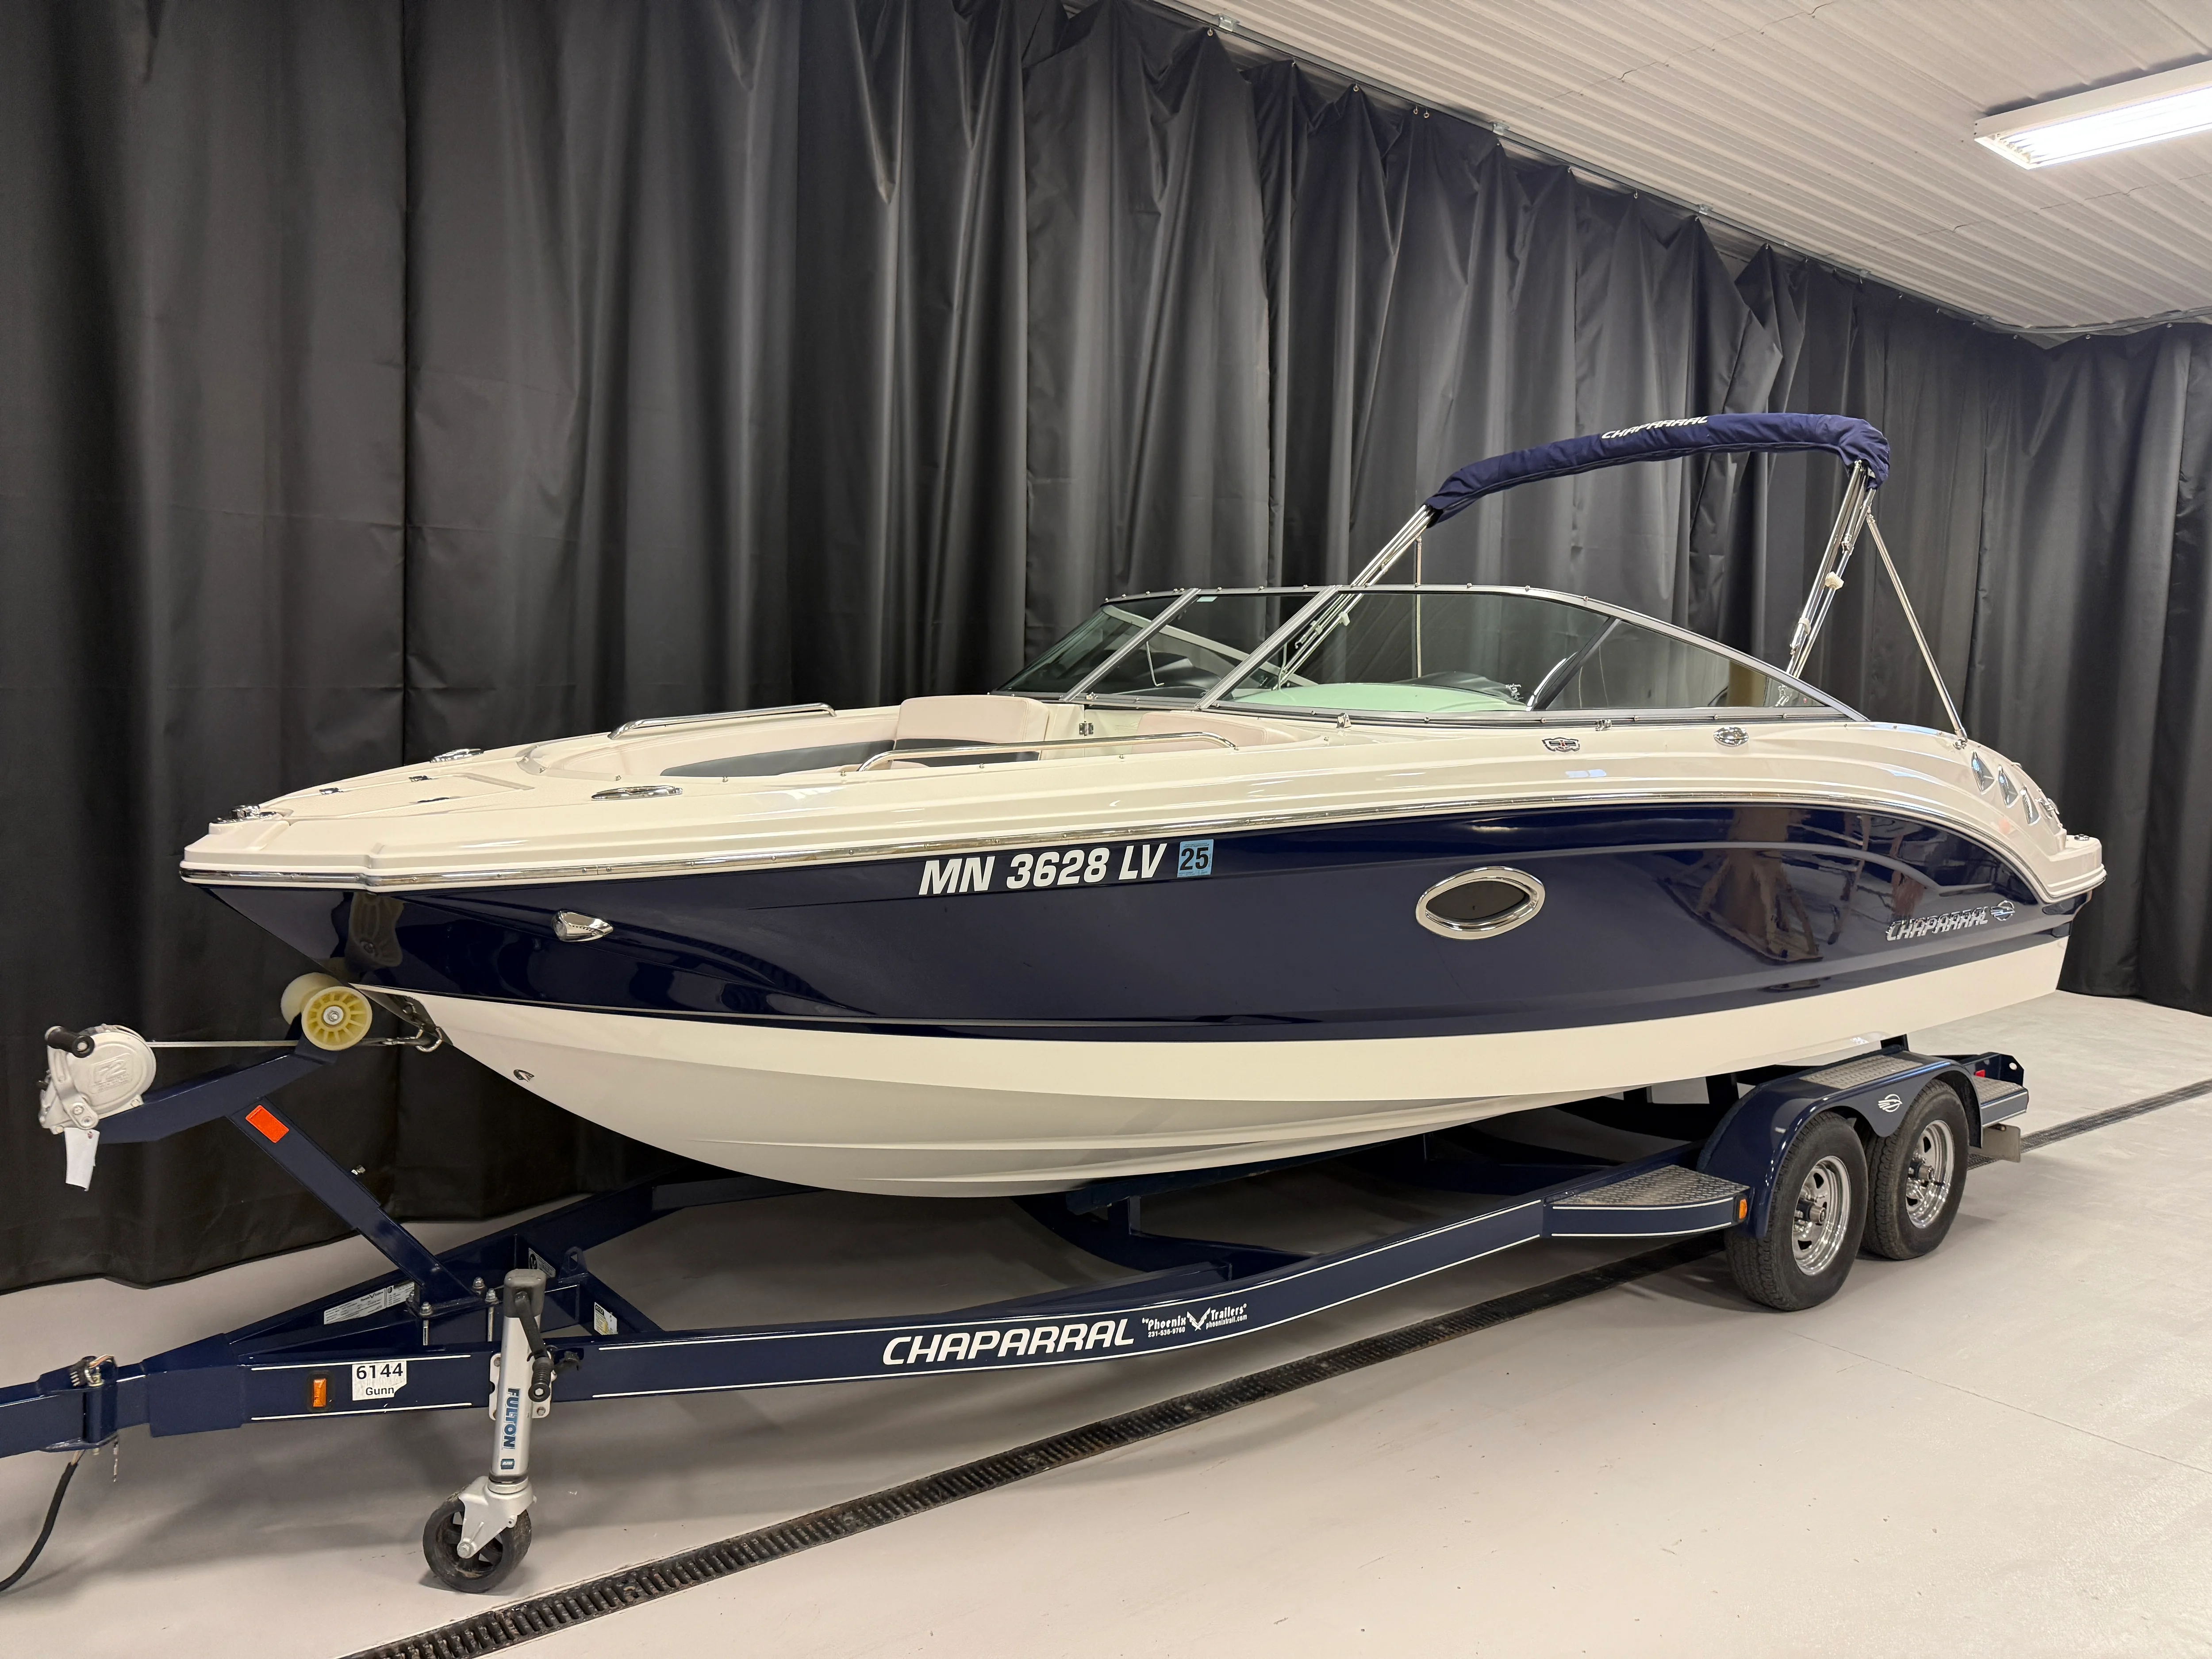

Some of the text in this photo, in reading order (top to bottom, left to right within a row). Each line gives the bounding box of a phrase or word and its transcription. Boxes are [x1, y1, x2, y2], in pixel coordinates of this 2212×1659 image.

[919, 843, 1167, 895] MN 3628 LV
[1179, 847, 1209, 871] 25
[1886, 906, 1988, 941] CHAPARRAL
[1148, 1315, 1187, 1331] Phoenix
[1206, 1314, 1248, 1330] phoenixtrail.com
[883, 1318, 1135, 1366] CHAPARRAL
[356, 1363, 403, 1380] 6144
[365, 1387, 394, 1396] Gunn
[503, 1388, 520, 1449] FULTON
